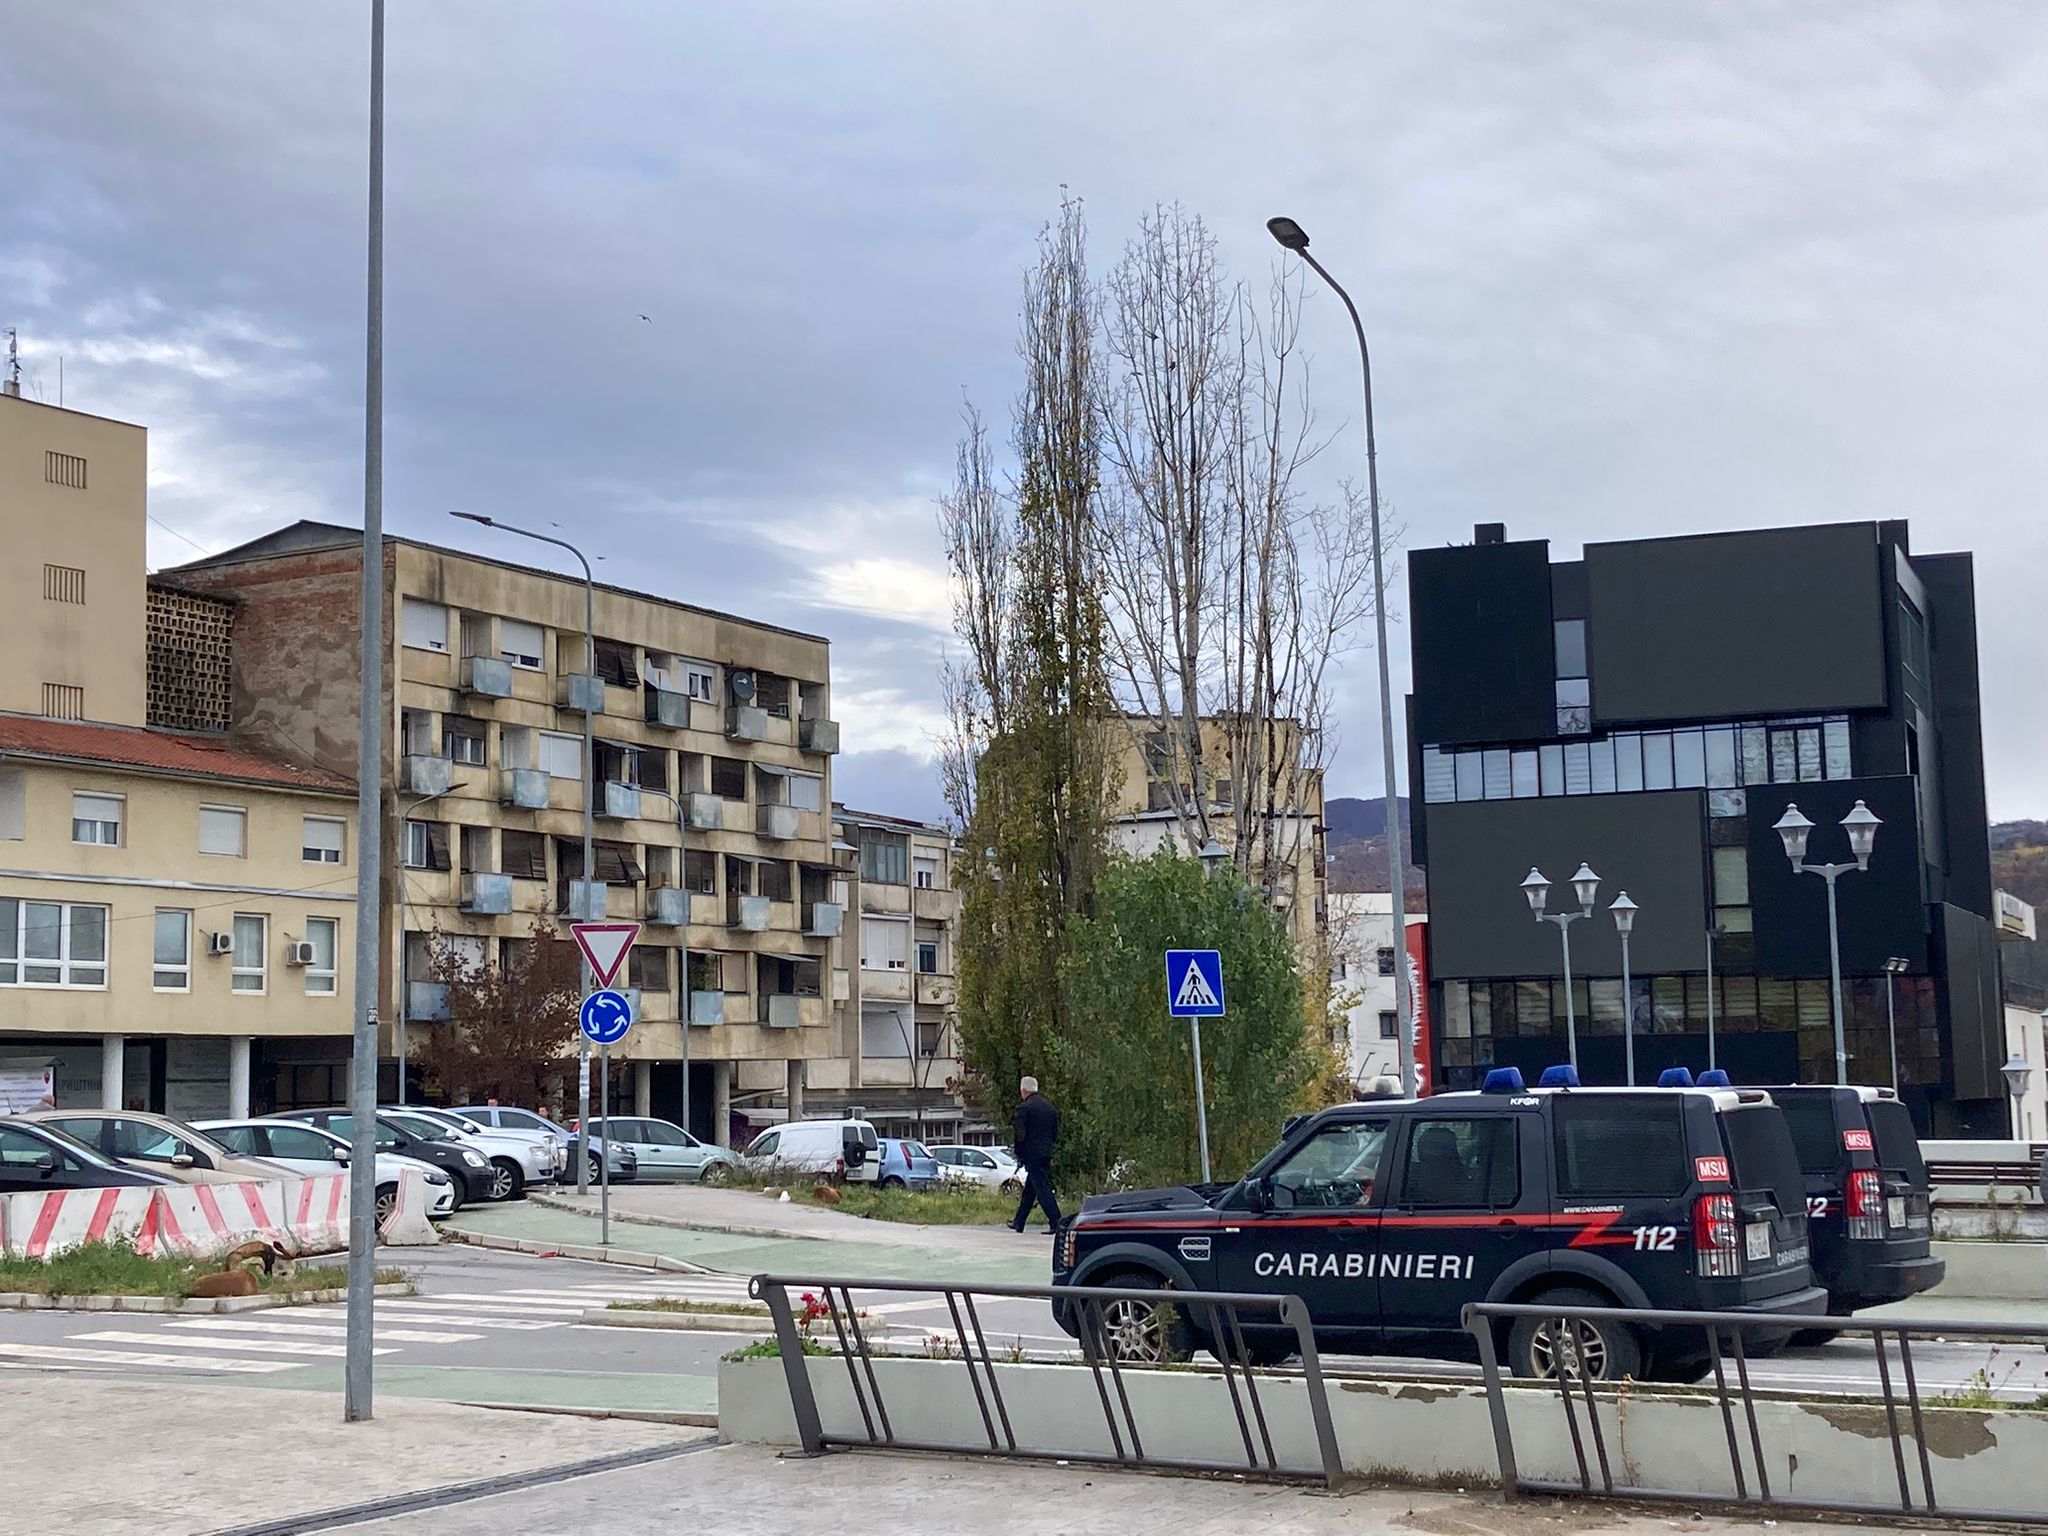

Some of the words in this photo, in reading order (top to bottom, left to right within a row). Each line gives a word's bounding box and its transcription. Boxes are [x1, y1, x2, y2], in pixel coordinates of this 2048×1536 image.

[1509, 1097, 1540, 1106] KFOR
[1847, 1133, 1871, 1147] MSU
[1699, 1161, 1727, 1177] MSU
[1632, 1226, 1677, 1251] 112
[1254, 1252, 1474, 1279] CARABINIERI
